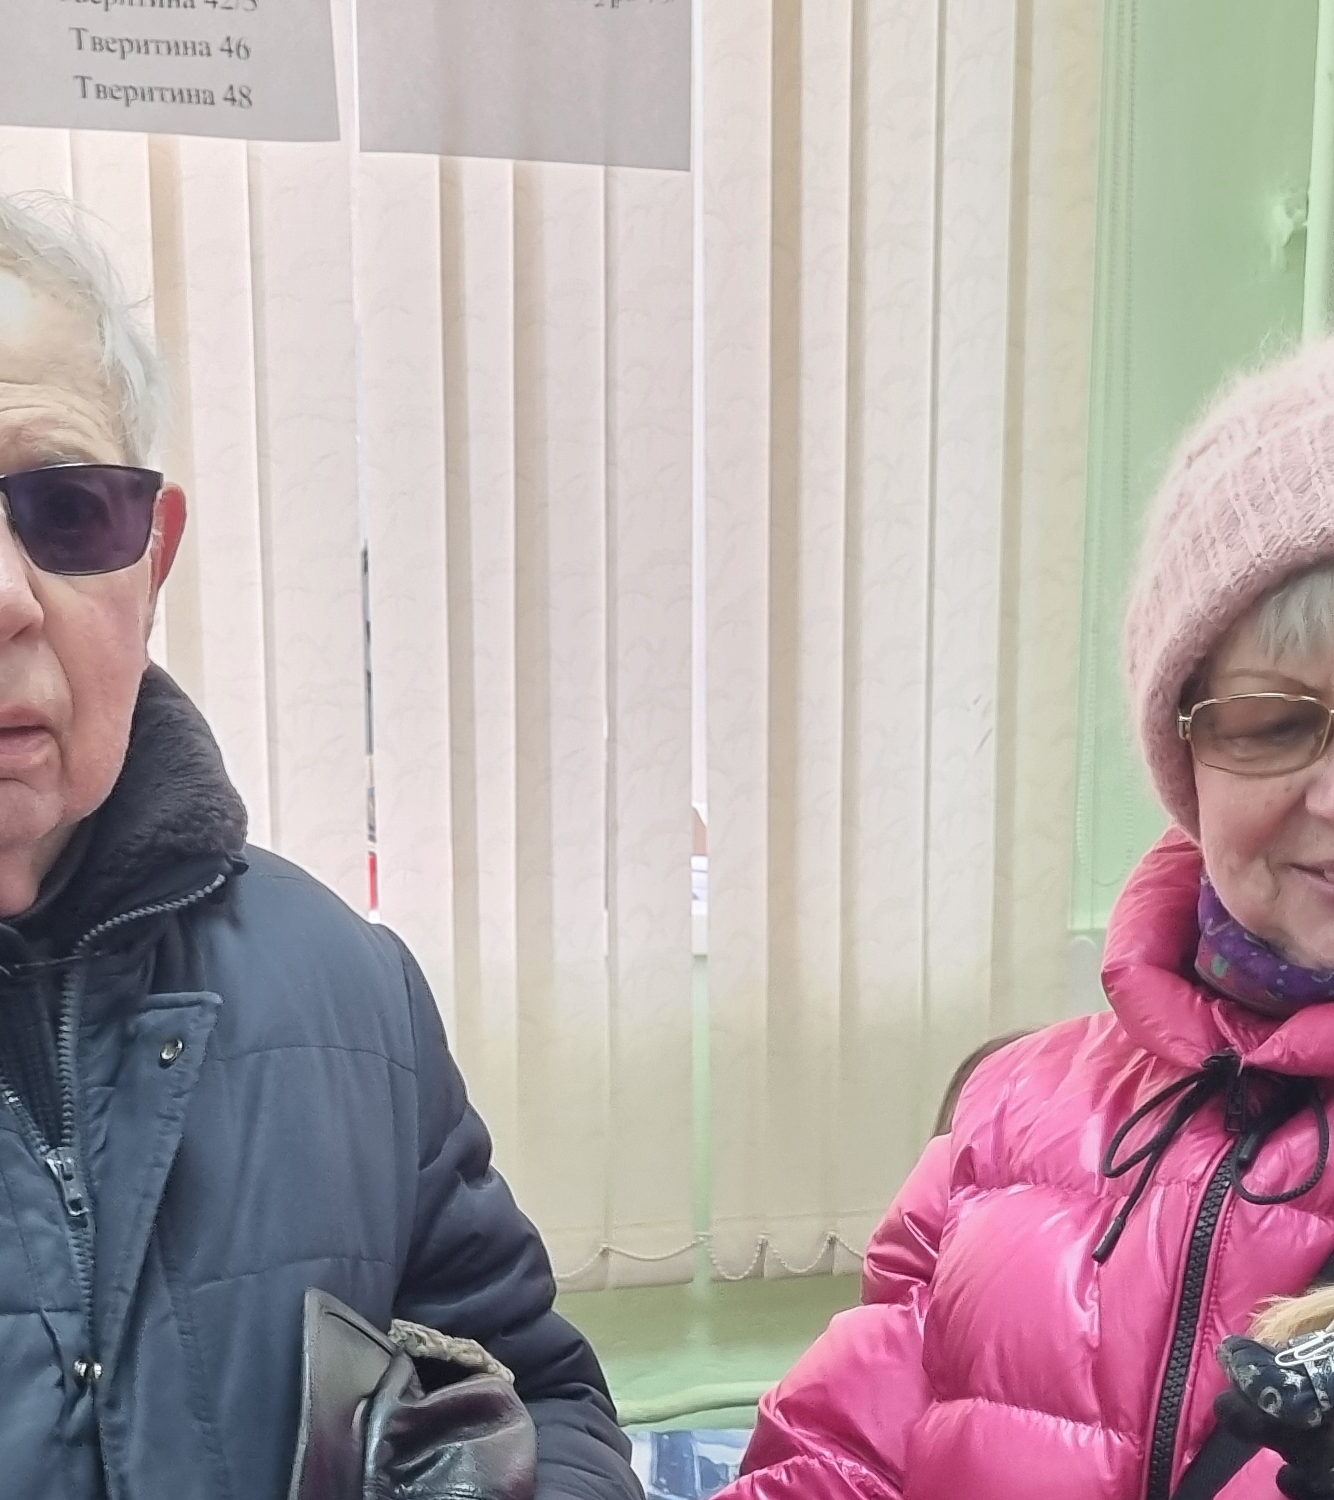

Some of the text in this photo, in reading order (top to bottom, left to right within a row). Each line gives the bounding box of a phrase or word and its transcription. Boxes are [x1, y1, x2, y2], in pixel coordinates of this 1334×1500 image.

[69, 27, 251, 60] Тверитина 46
[73, 75, 253, 109] Тверитина 48
